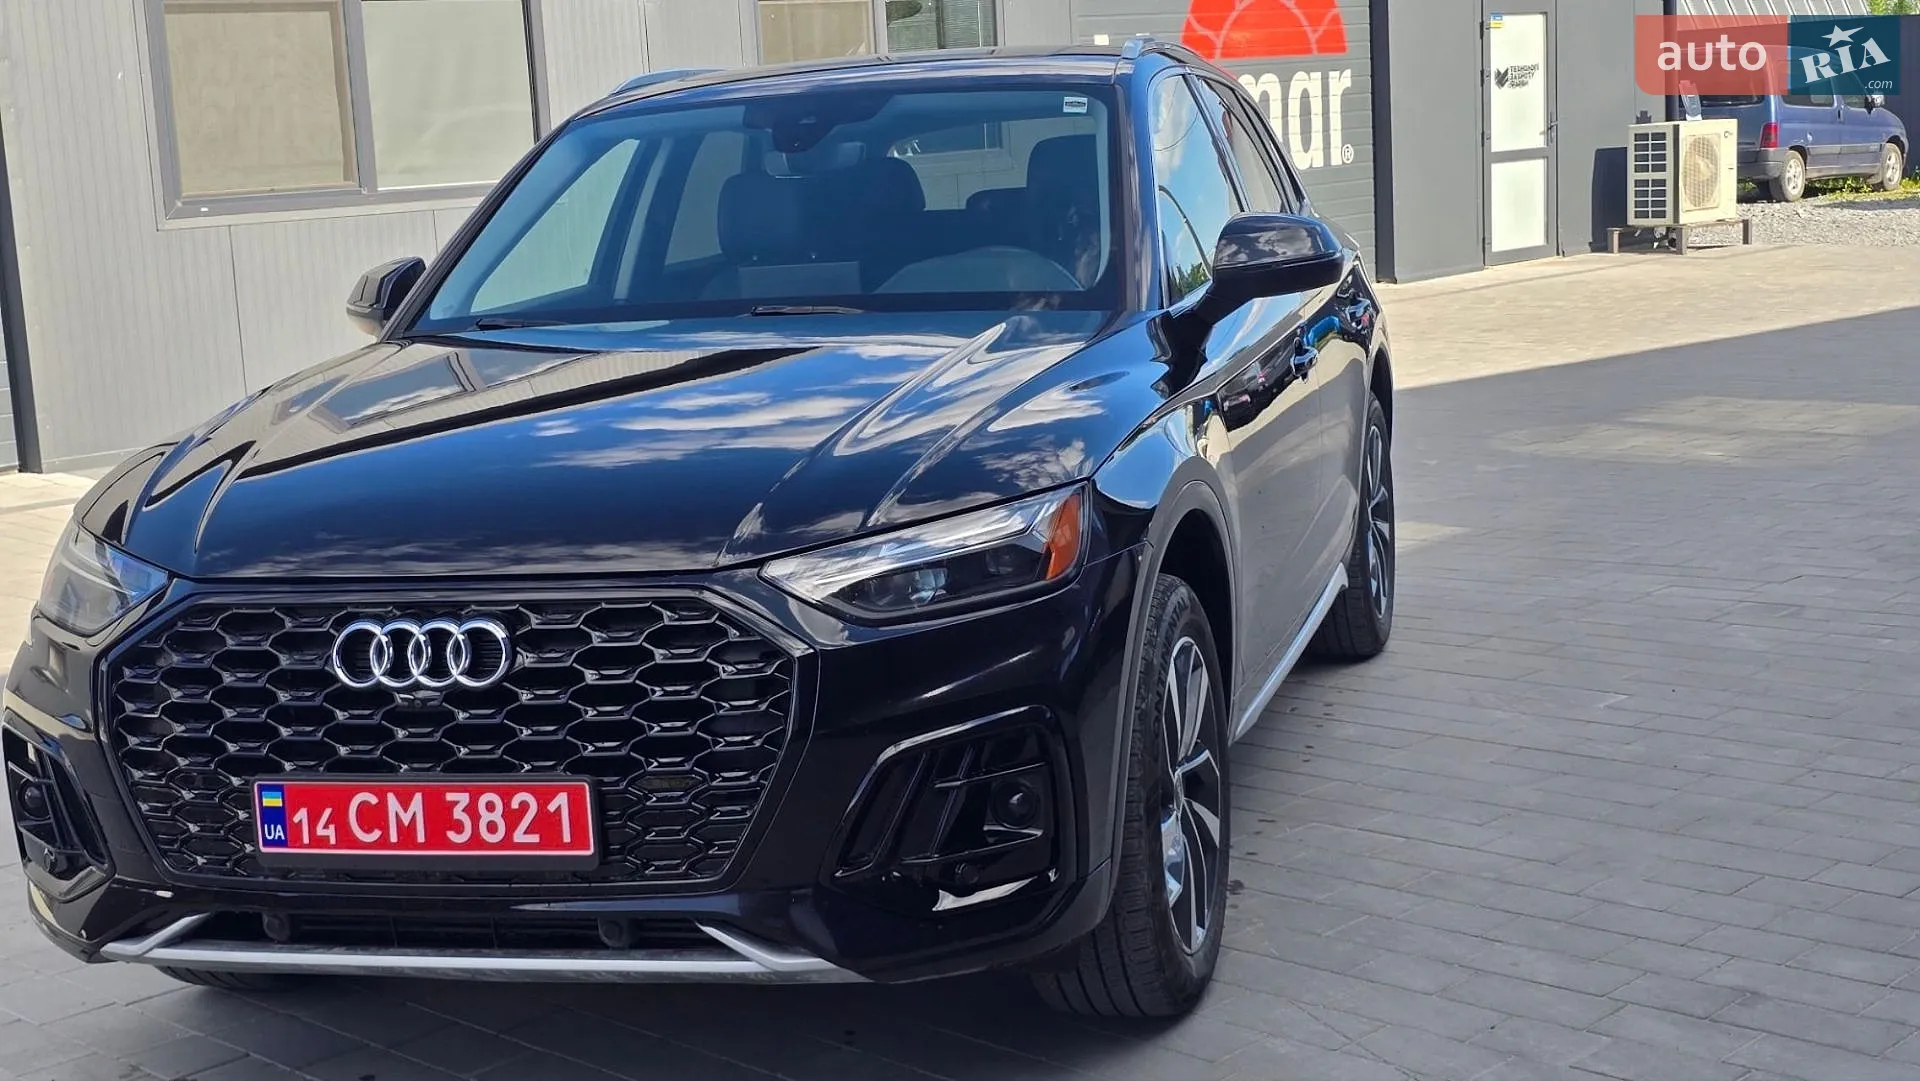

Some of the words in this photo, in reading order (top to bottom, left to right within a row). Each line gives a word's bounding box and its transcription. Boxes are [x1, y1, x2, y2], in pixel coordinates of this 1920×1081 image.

[264, 824, 285, 840] UA
[292, 807, 337, 845] 14
[348, 791, 426, 844] CM
[445, 791, 572, 844] 3821
